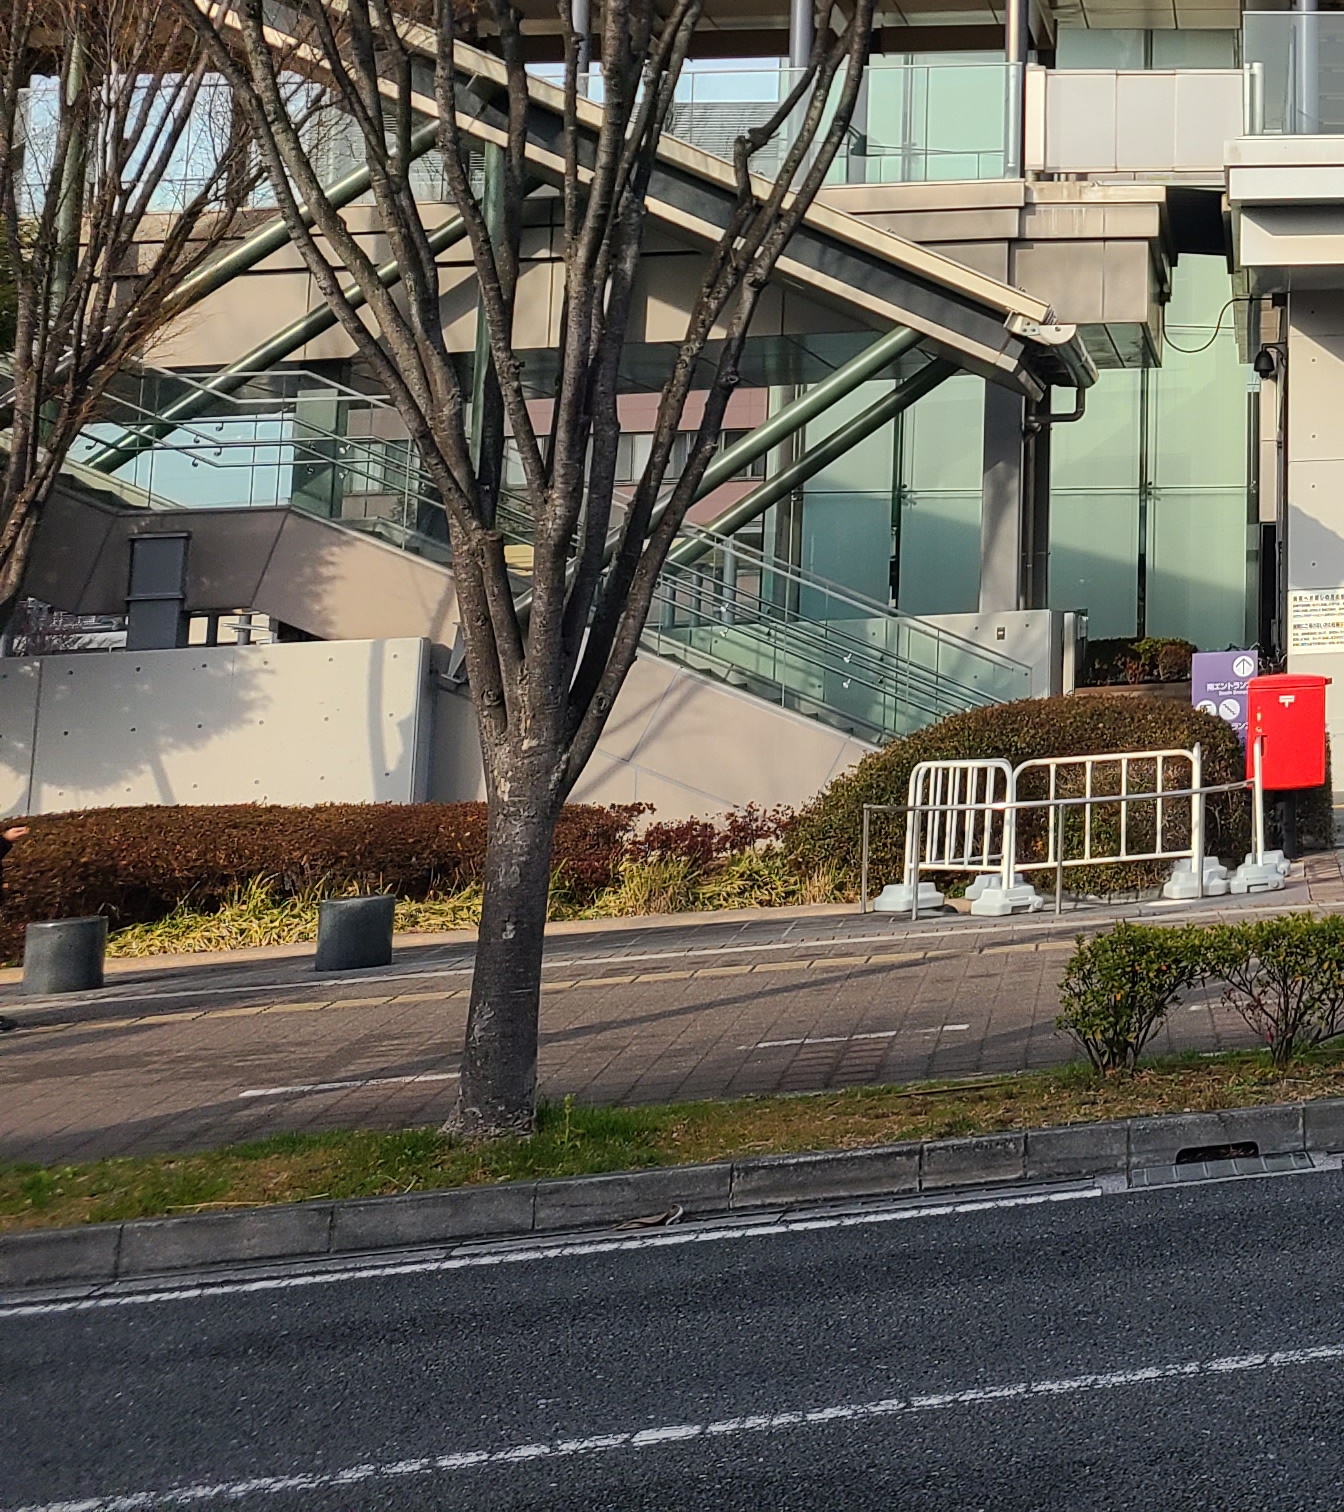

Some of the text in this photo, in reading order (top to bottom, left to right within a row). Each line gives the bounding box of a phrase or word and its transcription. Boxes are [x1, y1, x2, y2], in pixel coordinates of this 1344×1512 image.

[1206, 681, 1249, 692] 南エントラン
